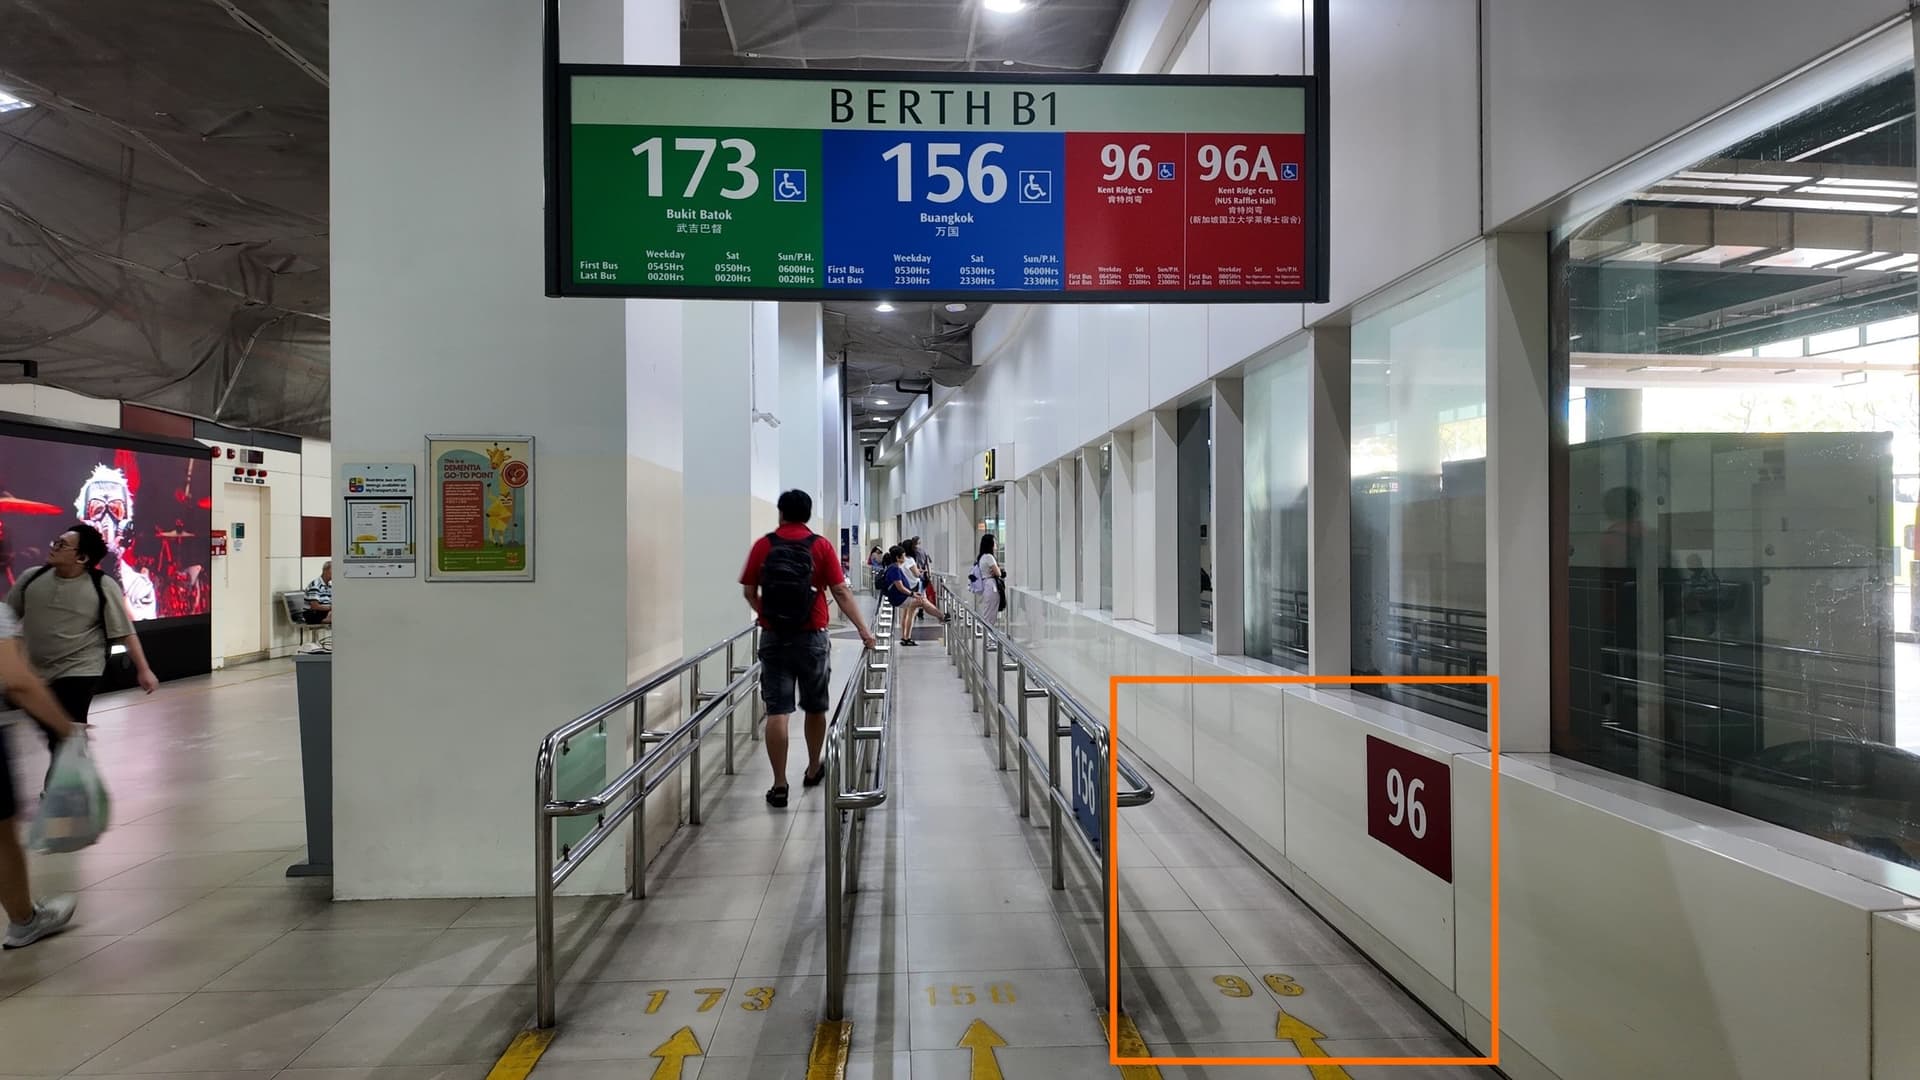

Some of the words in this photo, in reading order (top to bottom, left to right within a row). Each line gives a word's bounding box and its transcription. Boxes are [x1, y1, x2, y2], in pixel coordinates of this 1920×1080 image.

[831, 88, 990, 125] BERTH
[1013, 91, 1056, 126] B1
[631, 137, 759, 200] 173
[1100, 144, 1153, 181] 96
[1197, 144, 1278, 181] 96A
[881, 142, 1008, 204] 156
[1097, 186, 1114, 194] Kent
[1116, 186, 1137, 196] Ridge
[1138, 186, 1153, 194] Cres
[1218, 187, 1235, 195] Kent
[1236, 187, 1257, 196] Ridge
[1258, 187, 1273, 195] Cres
[1215, 197, 1232, 206] (NUS
[1233, 197, 1258, 205] Raffles
[1260, 197, 1276, 206] Hall)
[666, 208, 696, 219] Bukit
[700, 209, 732, 220] Batok
[920, 212, 974, 226] Buangkok
[676, 223, 722, 234] 武吉巴督
[935, 226, 959, 237] 万国
[646, 250, 685, 261] Weekday
[726, 251, 739, 260] Sat
[778, 252, 814, 262] Sun/P.H.
[893, 253, 931, 264] Weekday
[971, 254, 984, 263] Sat
[1023, 255, 1059, 264] Sun/P.H.
[580, 261, 599, 270] First
[602, 261, 618, 270] Bus
[647, 262, 684, 271] 0545Hrs
[715, 263, 751, 273] 0550Hrs
[778, 264, 814, 274] 0600Hrs
[828, 265, 846, 274] First
[849, 265, 864, 274] Bus
[895, 266, 930, 276] 0530Hrs
[960, 266, 995, 276] 0530Hrs
[1024, 267, 1059, 276] 0600Hrs
[580, 271, 598, 280] Last
[600, 271, 616, 280] Bus
[647, 272, 684, 282] 0020Hrs
[715, 274, 751, 283] 0020Hrs
[778, 275, 815, 284] 0020Hrs
[828, 275, 845, 284] Last
[847, 275, 862, 284] Bus
[895, 276, 930, 285] 2330Hrs
[960, 276, 995, 285] 2330Hrs
[1024, 277, 1059, 286] 2330Hrs
[1075, 745, 1096, 816] 156
[1386, 767, 1427, 839] 96
[1212, 974, 1305, 998] 96
[644, 986, 775, 1015] 173
